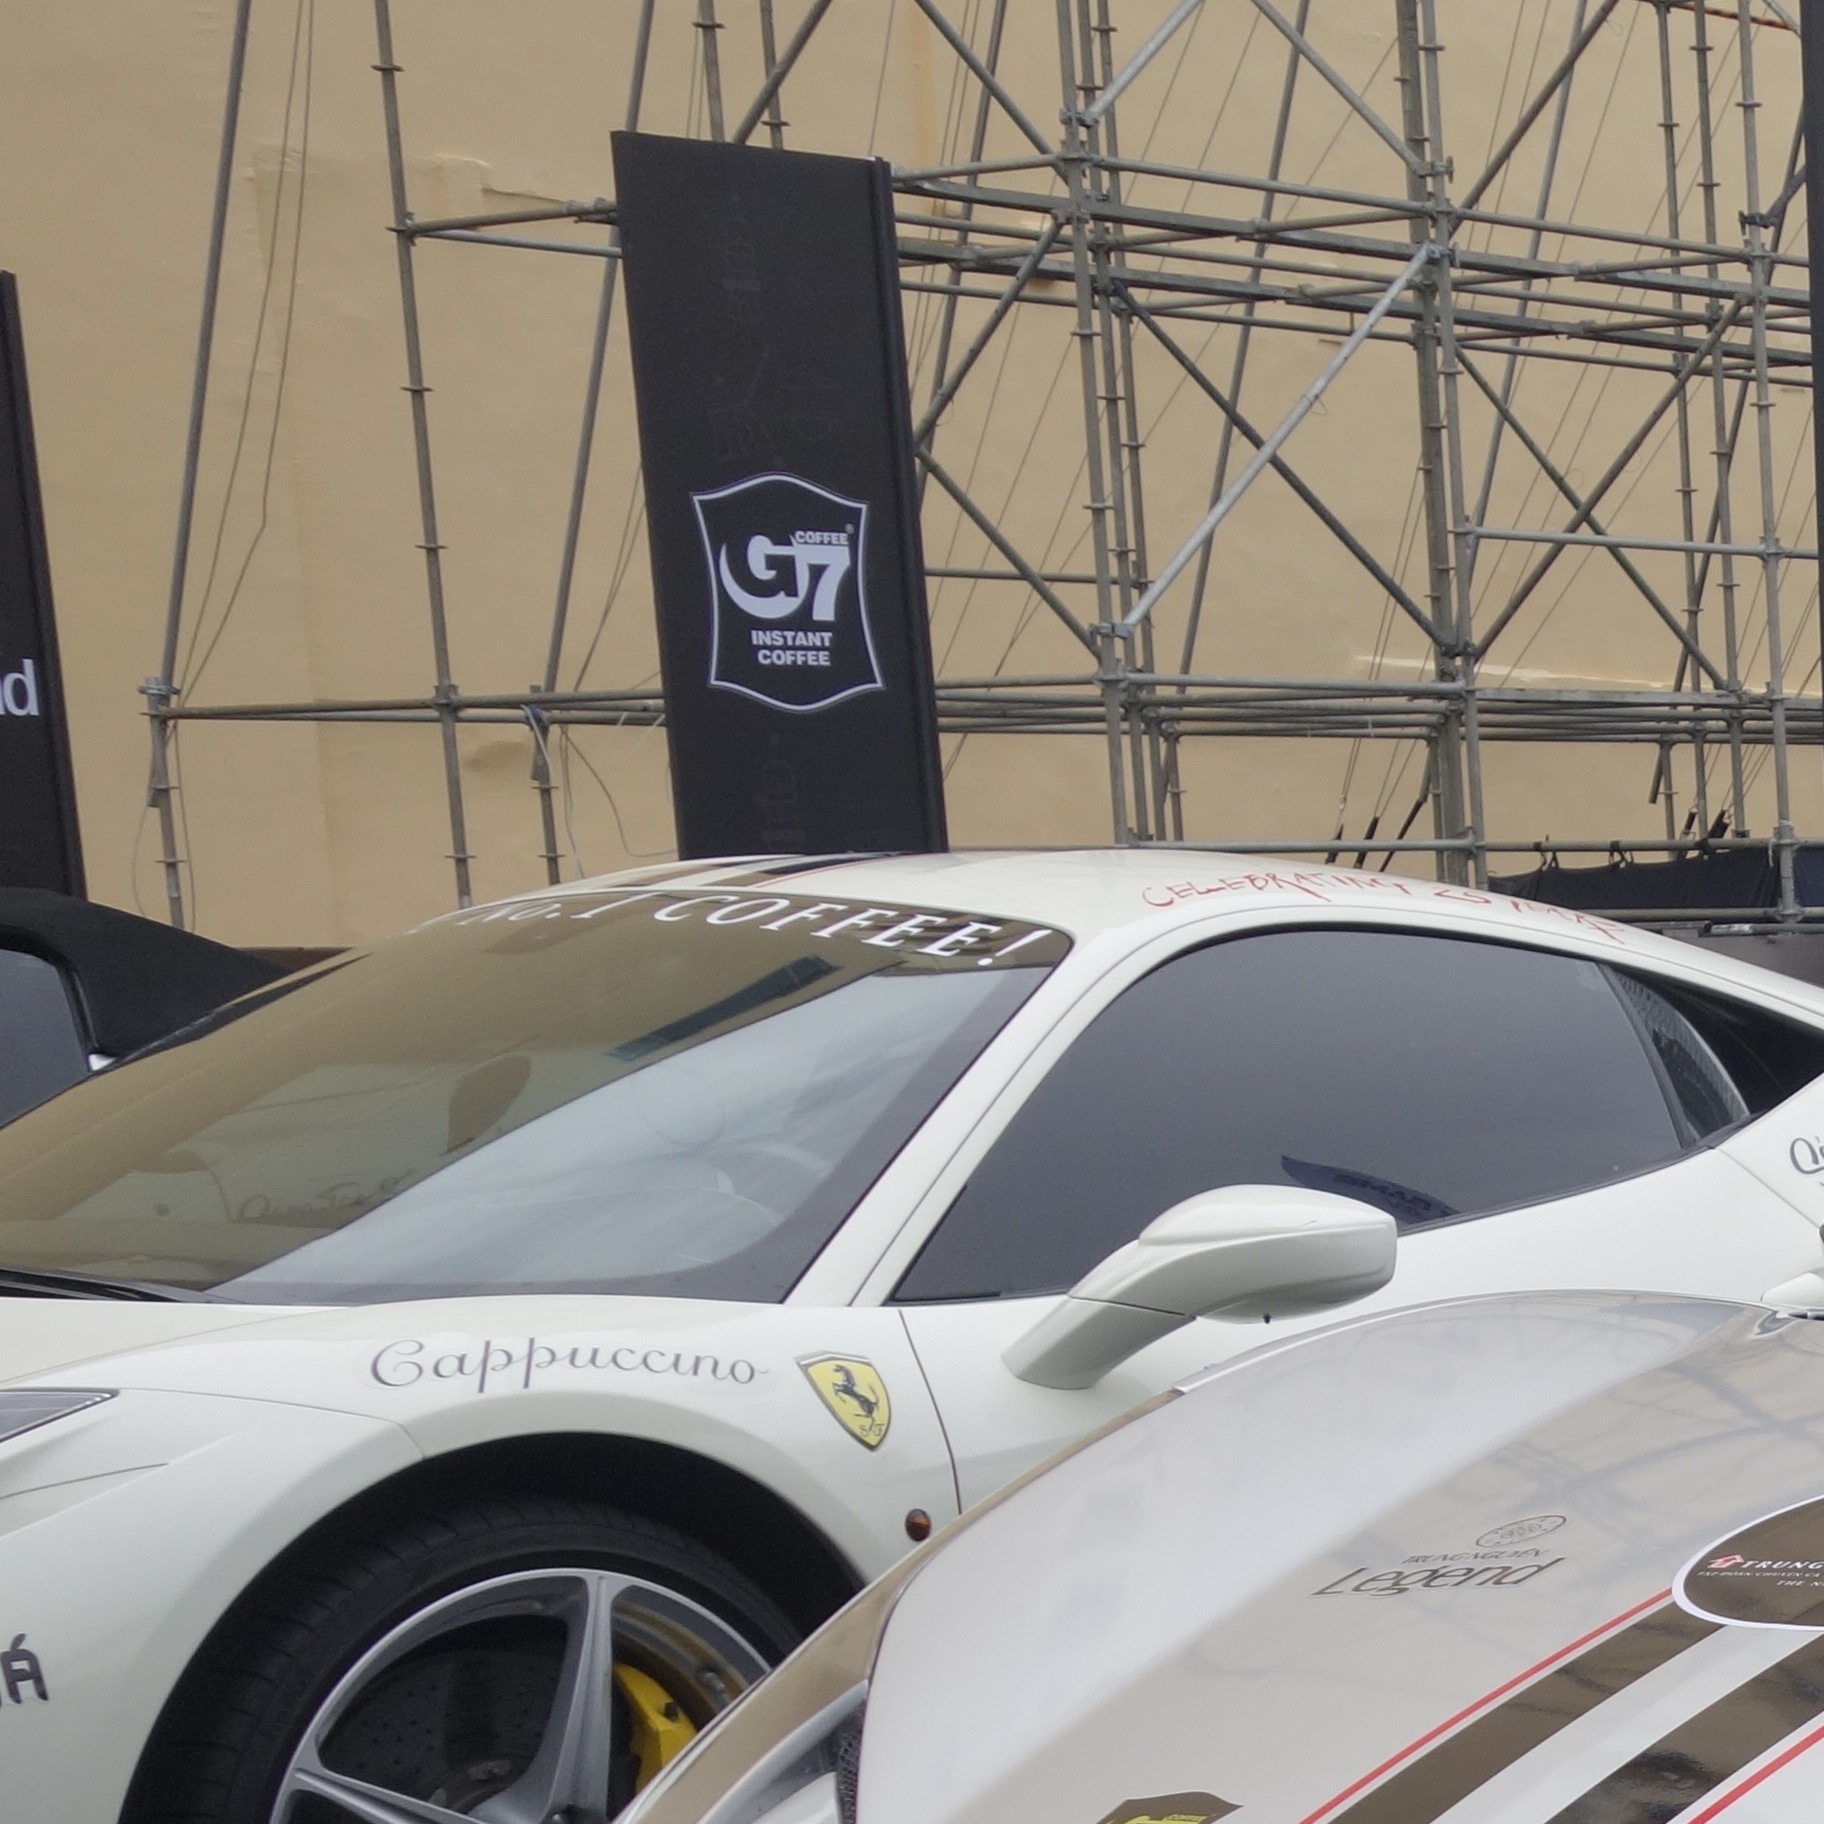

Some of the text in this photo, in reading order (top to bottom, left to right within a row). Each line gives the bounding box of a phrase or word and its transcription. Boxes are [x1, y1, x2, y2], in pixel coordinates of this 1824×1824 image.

[794, 530, 850, 547] COFFEE
[718, 533, 851, 621] G7
[750, 628, 833, 648] INSTANT
[757, 648, 831, 667] COFFEE
[653, 894, 1053, 967] COFFEE!
[369, 1336, 769, 1394] Cappuccino
[1311, 1556, 1566, 1598] Legend
[0, 1632, 49, 1708] Á
